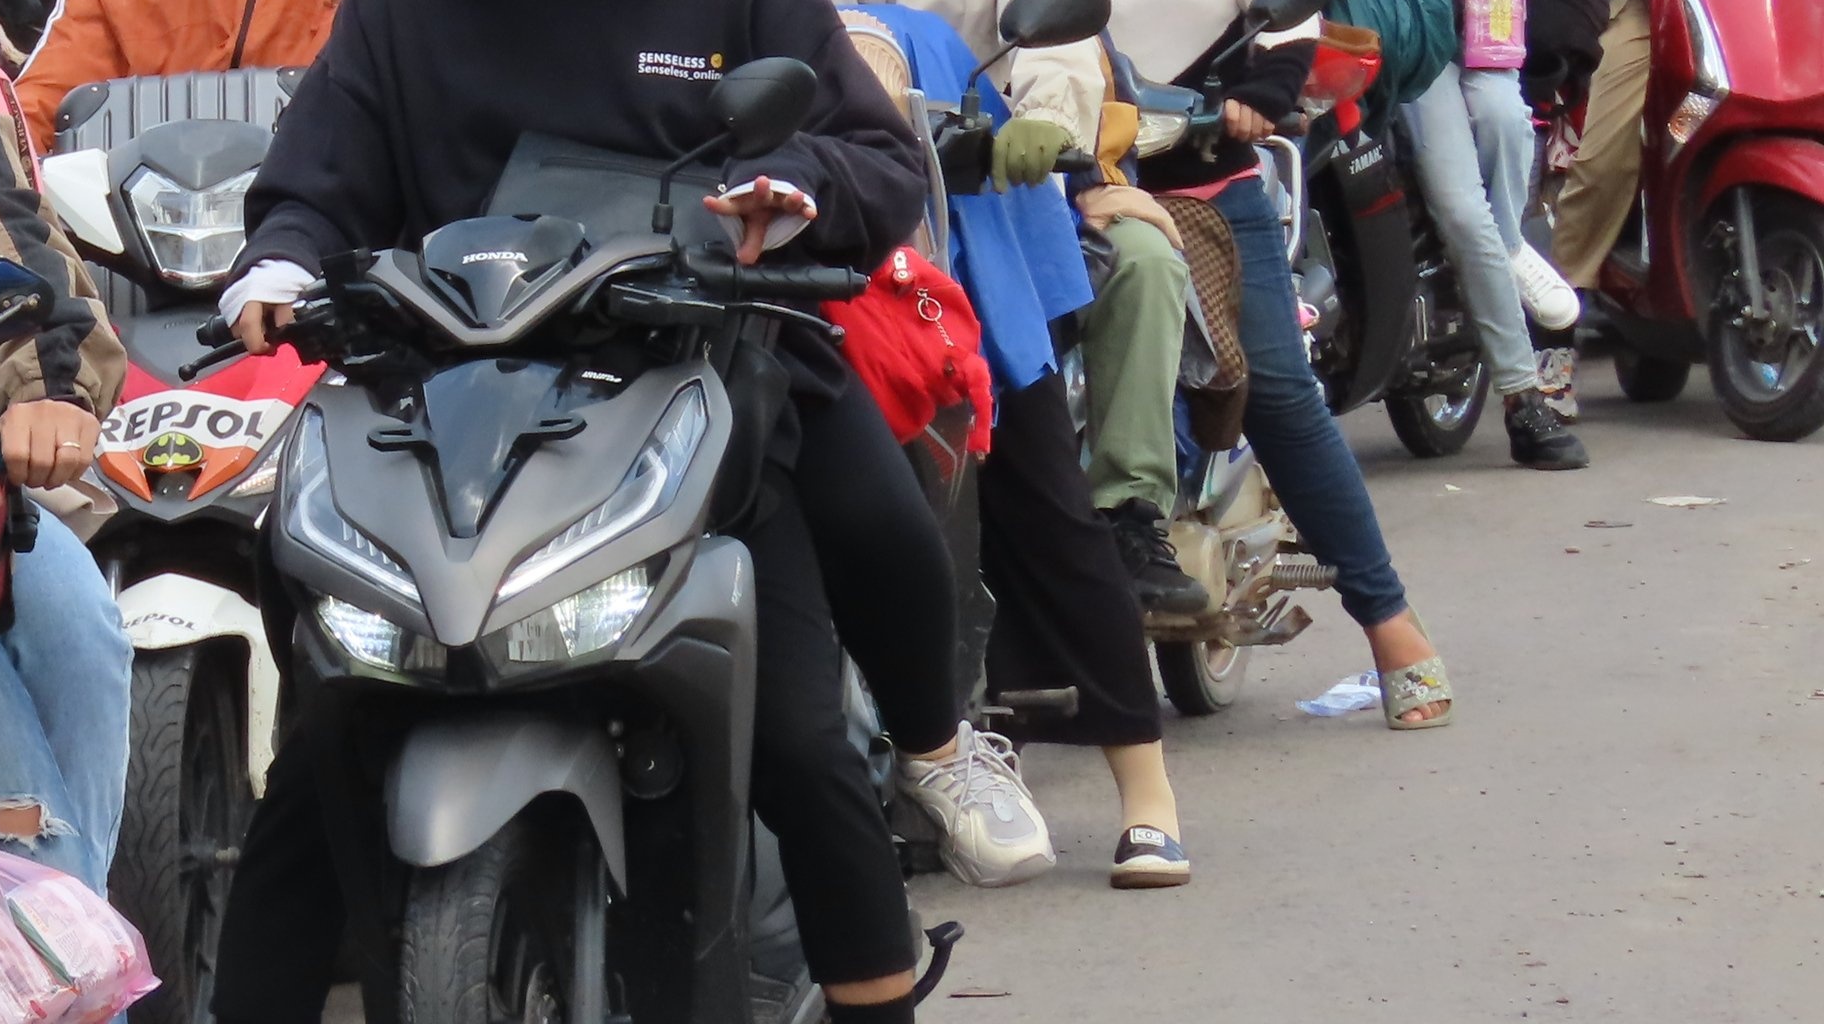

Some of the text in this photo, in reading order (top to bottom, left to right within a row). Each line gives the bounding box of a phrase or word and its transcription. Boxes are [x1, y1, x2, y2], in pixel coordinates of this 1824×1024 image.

[638, 52, 706, 68] SENSELESS
[462, 251, 528, 264] HONDA
[99, 401, 263, 443] REPSOL
